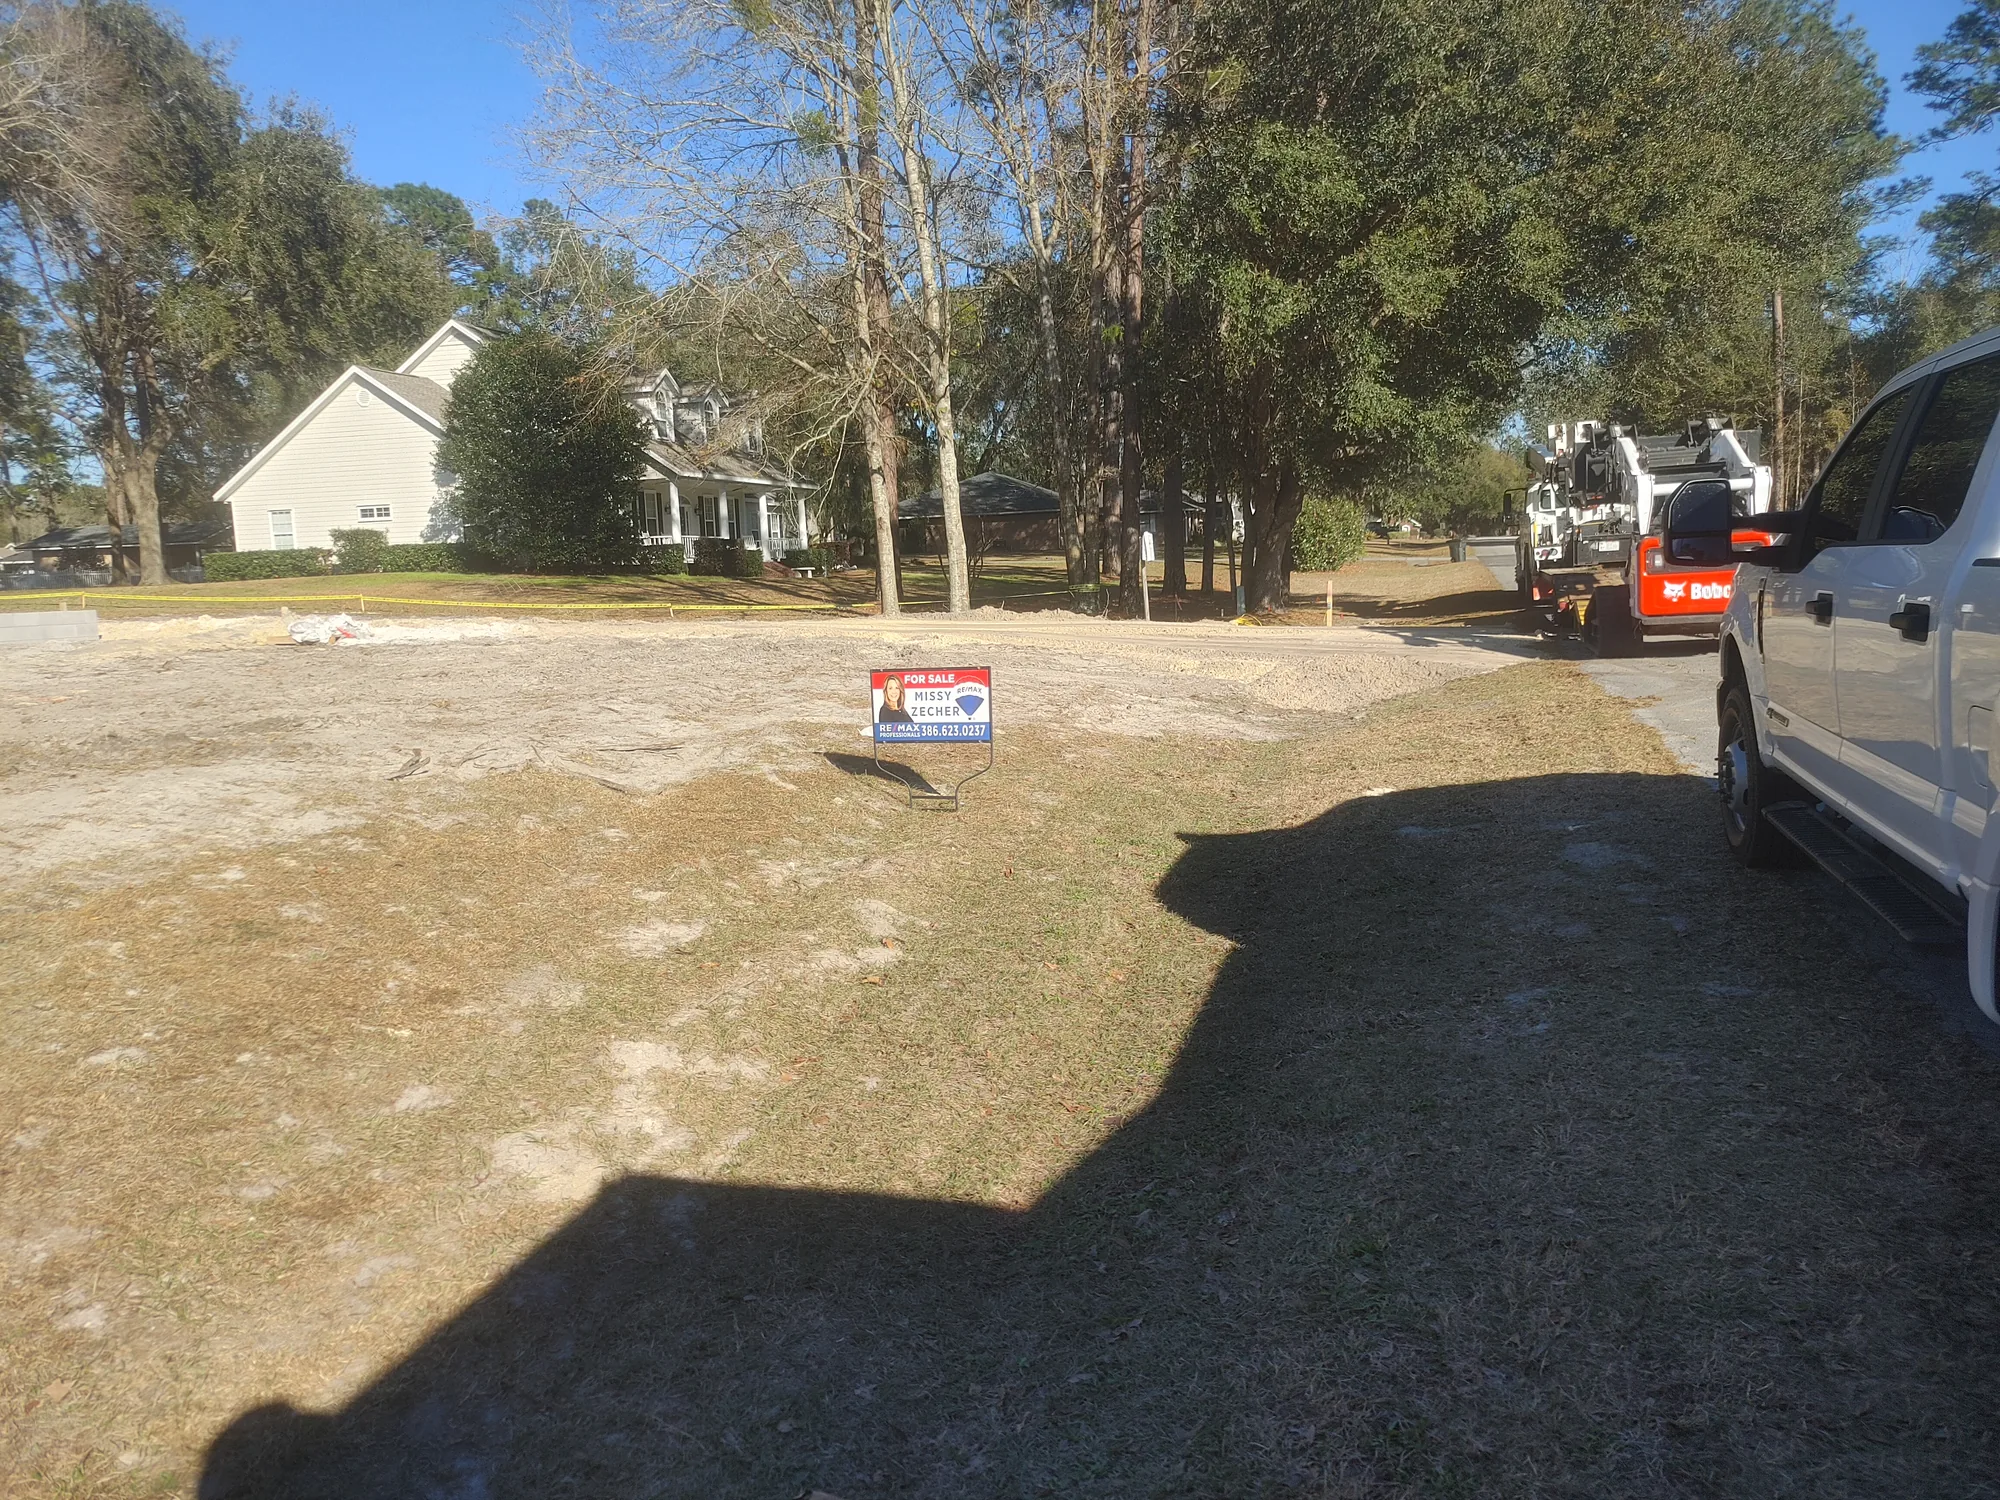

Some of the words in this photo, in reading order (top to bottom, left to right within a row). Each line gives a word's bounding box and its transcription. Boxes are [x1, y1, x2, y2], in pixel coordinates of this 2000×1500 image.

[904, 675, 926, 684] FOR
[928, 674, 955, 683] SALE
[957, 686, 983, 694] RE/MAX
[914, 691, 952, 701] MISSY
[911, 706, 960, 716] ZECHER
[879, 724, 920, 732] RE/MAX
[921, 725, 986, 736] 386.623.0237
